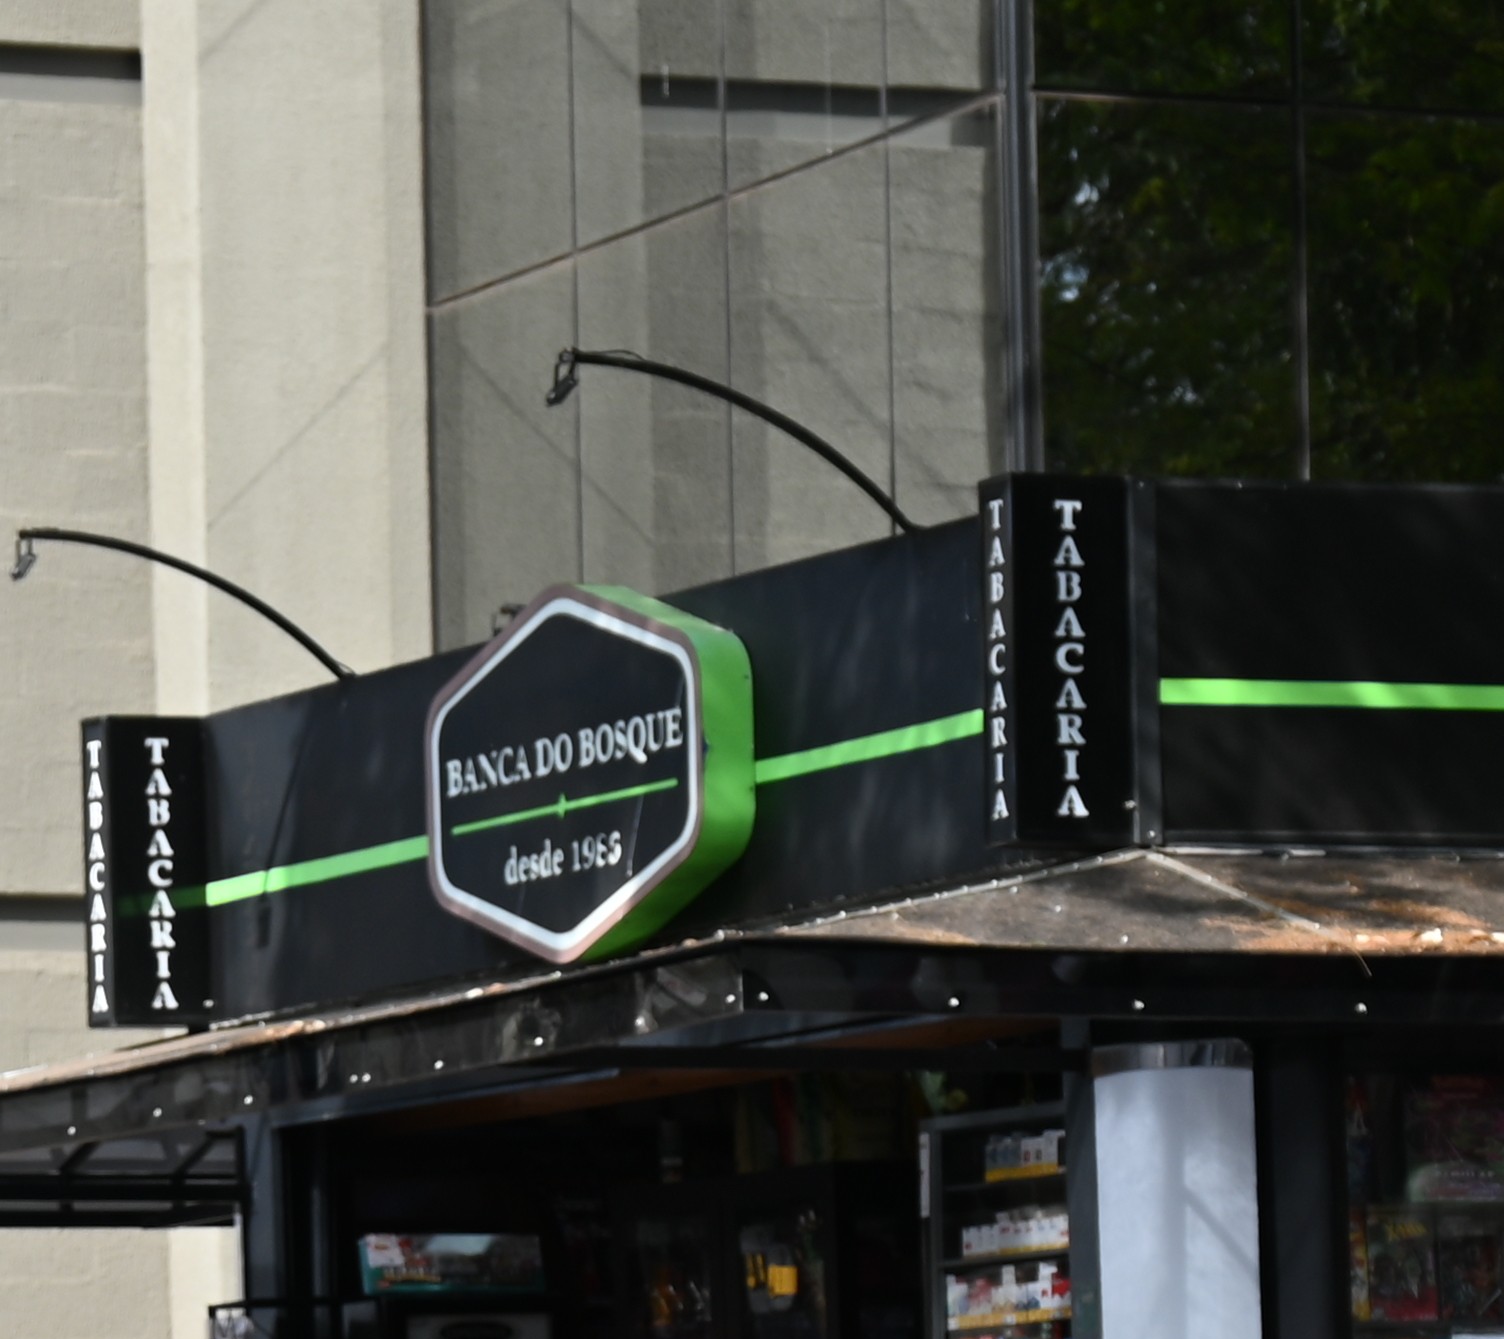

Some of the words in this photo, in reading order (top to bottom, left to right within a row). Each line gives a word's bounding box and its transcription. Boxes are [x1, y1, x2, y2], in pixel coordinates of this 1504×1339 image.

[446, 746, 532, 798] BANCA
[535, 733, 573, 778] DO
[578, 707, 683, 767] BOSQUE
[989, 498, 1009, 820] TABACARIA
[1053, 498, 1090, 817] TABACARIA
[86, 739, 109, 1012] TABACARIA
[144, 737, 179, 1010] TABACARIA
[504, 838, 564, 885] desde
